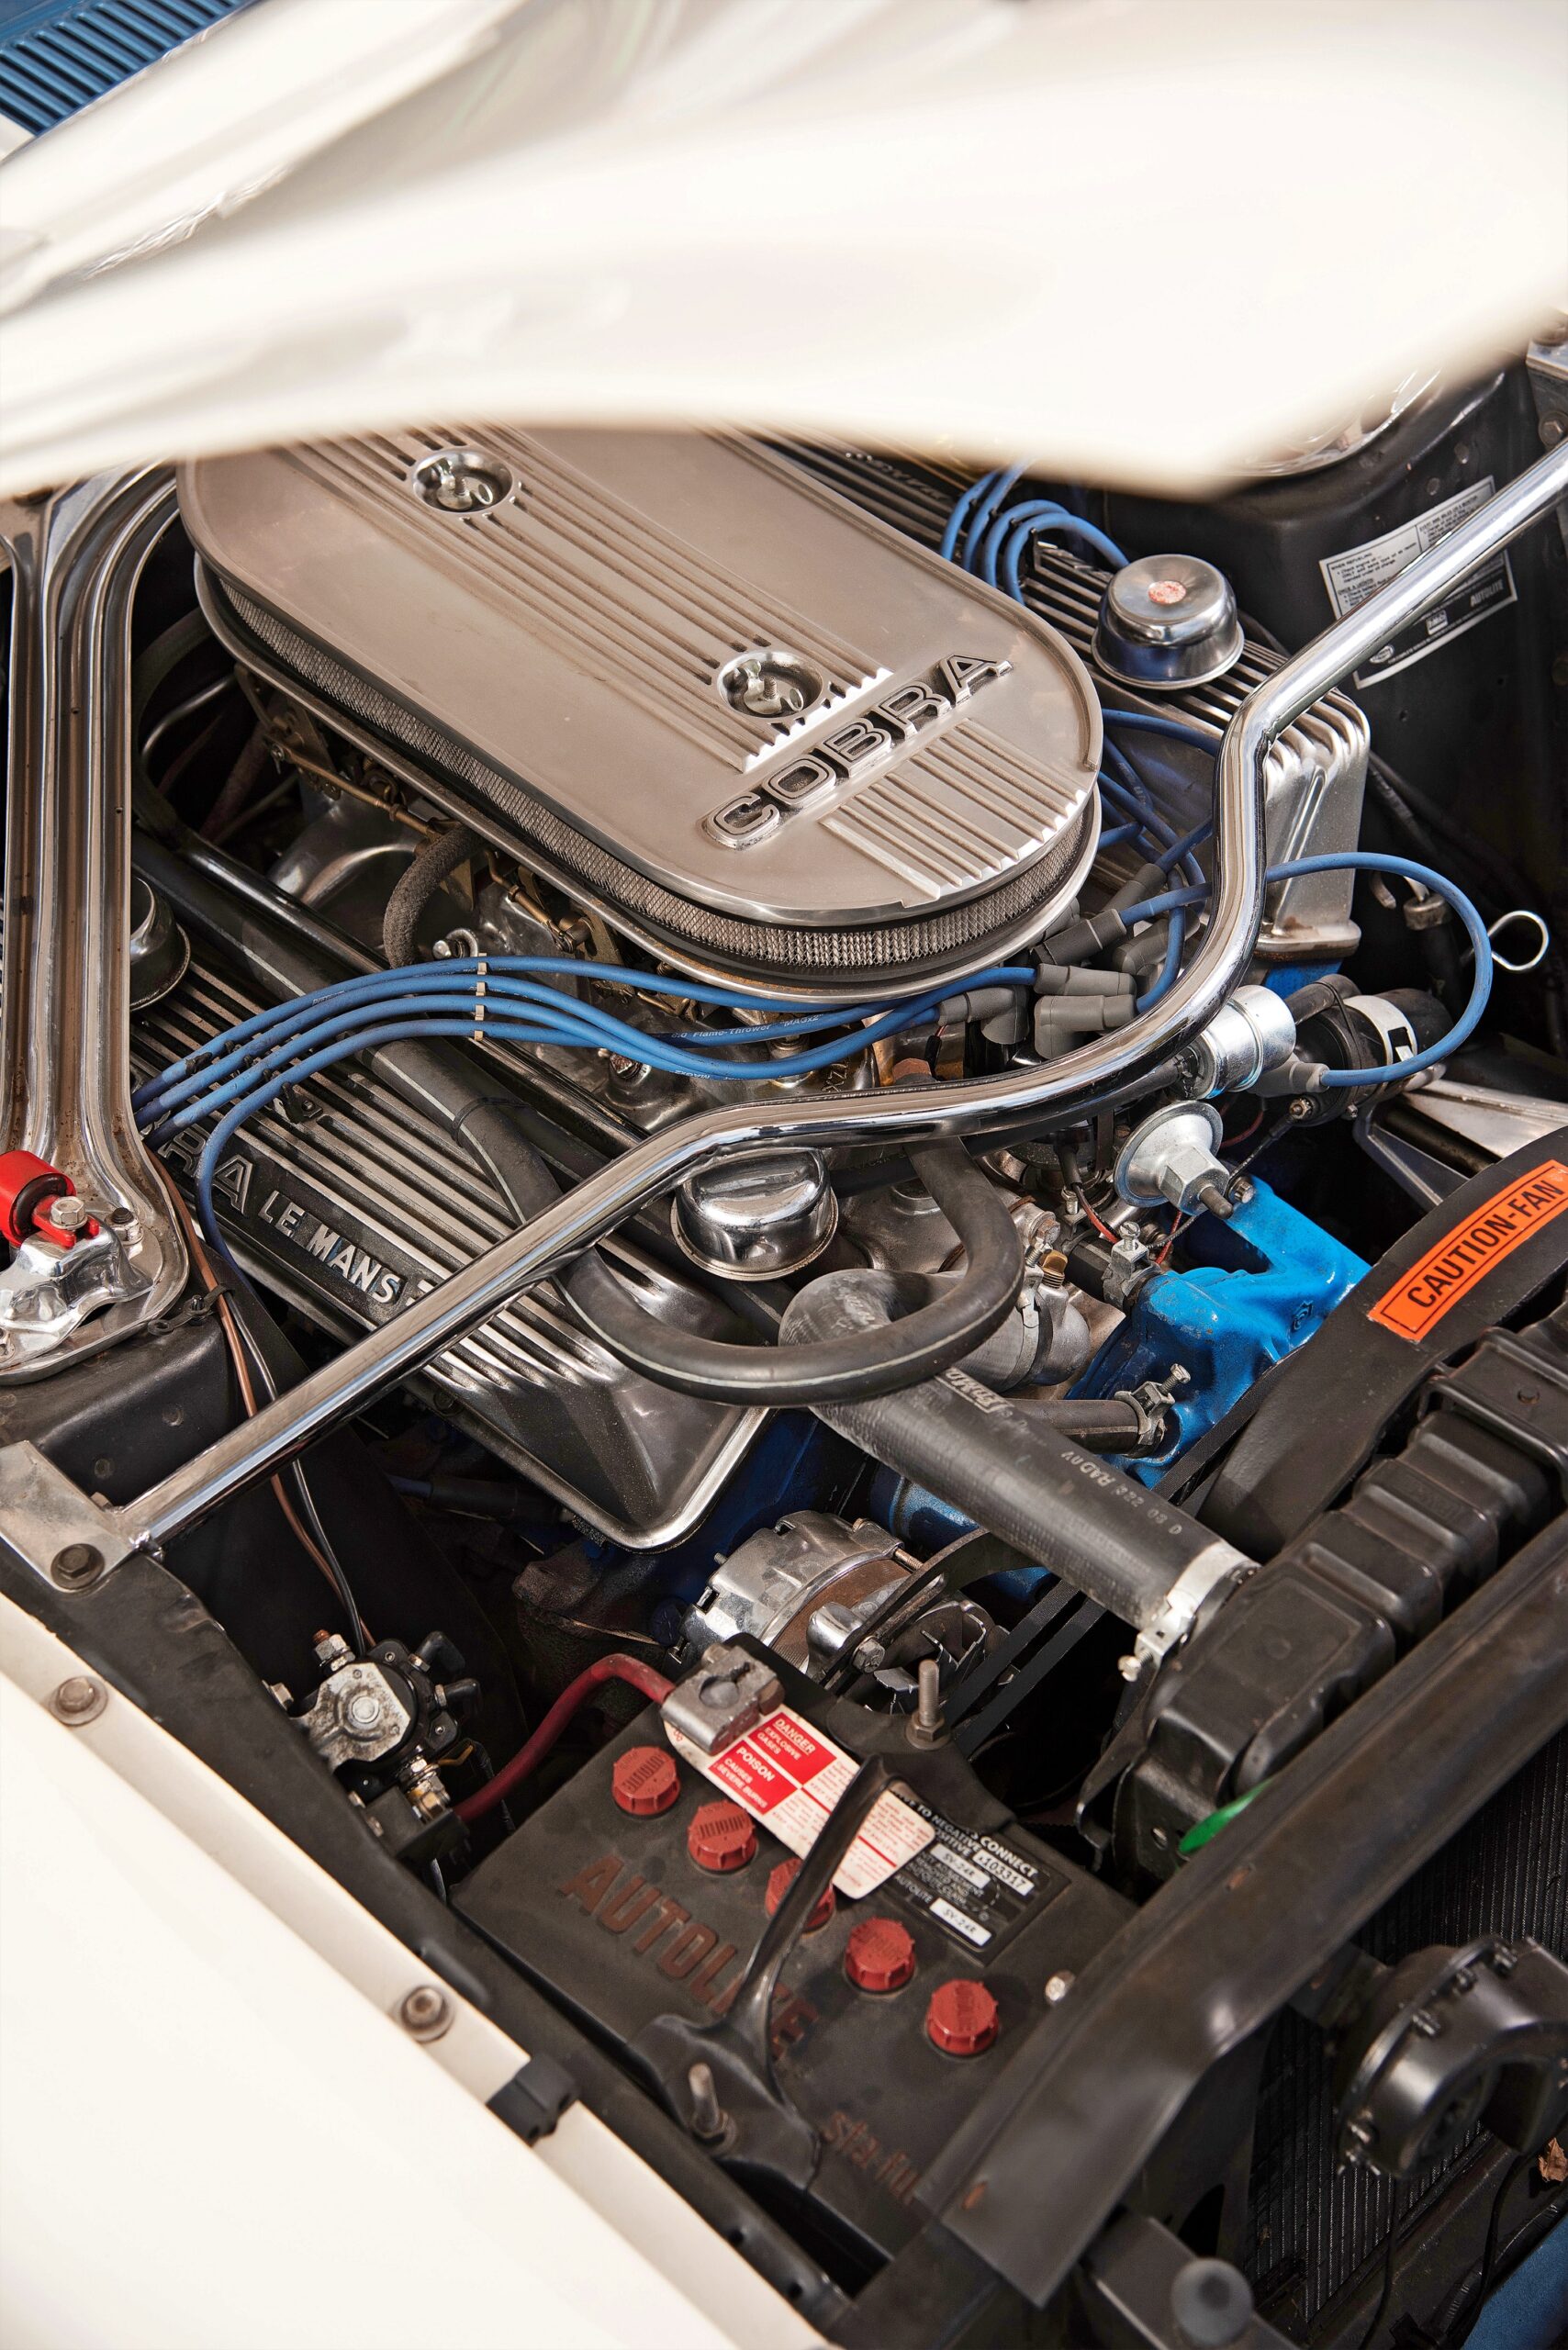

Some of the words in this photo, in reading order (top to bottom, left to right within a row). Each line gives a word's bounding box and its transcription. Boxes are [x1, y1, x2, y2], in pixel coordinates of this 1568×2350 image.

[701, 654, 1012, 850] COBRA
[692, 1024, 772, 1038] Flame-Thrower
[258, 1191, 306, 1238] LE
[308, 1223, 401, 1304] MANS
[1406, 1180, 1564, 1308] CAUTION-FAN
[756, 1732, 781, 1755] GASES
[764, 1727, 801, 1761] EXPLOSIVE
[775, 1718, 816, 1754] DANGER
[724, 1757, 753, 1784] CAUSES
[736, 1747, 776, 1782] POISON
[716, 1763, 745, 1787] SEVERE
[743, 1785, 768, 1808] BURNS
[932, 1815, 982, 1852] NEGATIVE
[935, 1828, 973, 1857] OSITIVE
[980, 1837, 1038, 1878] CONNECT
